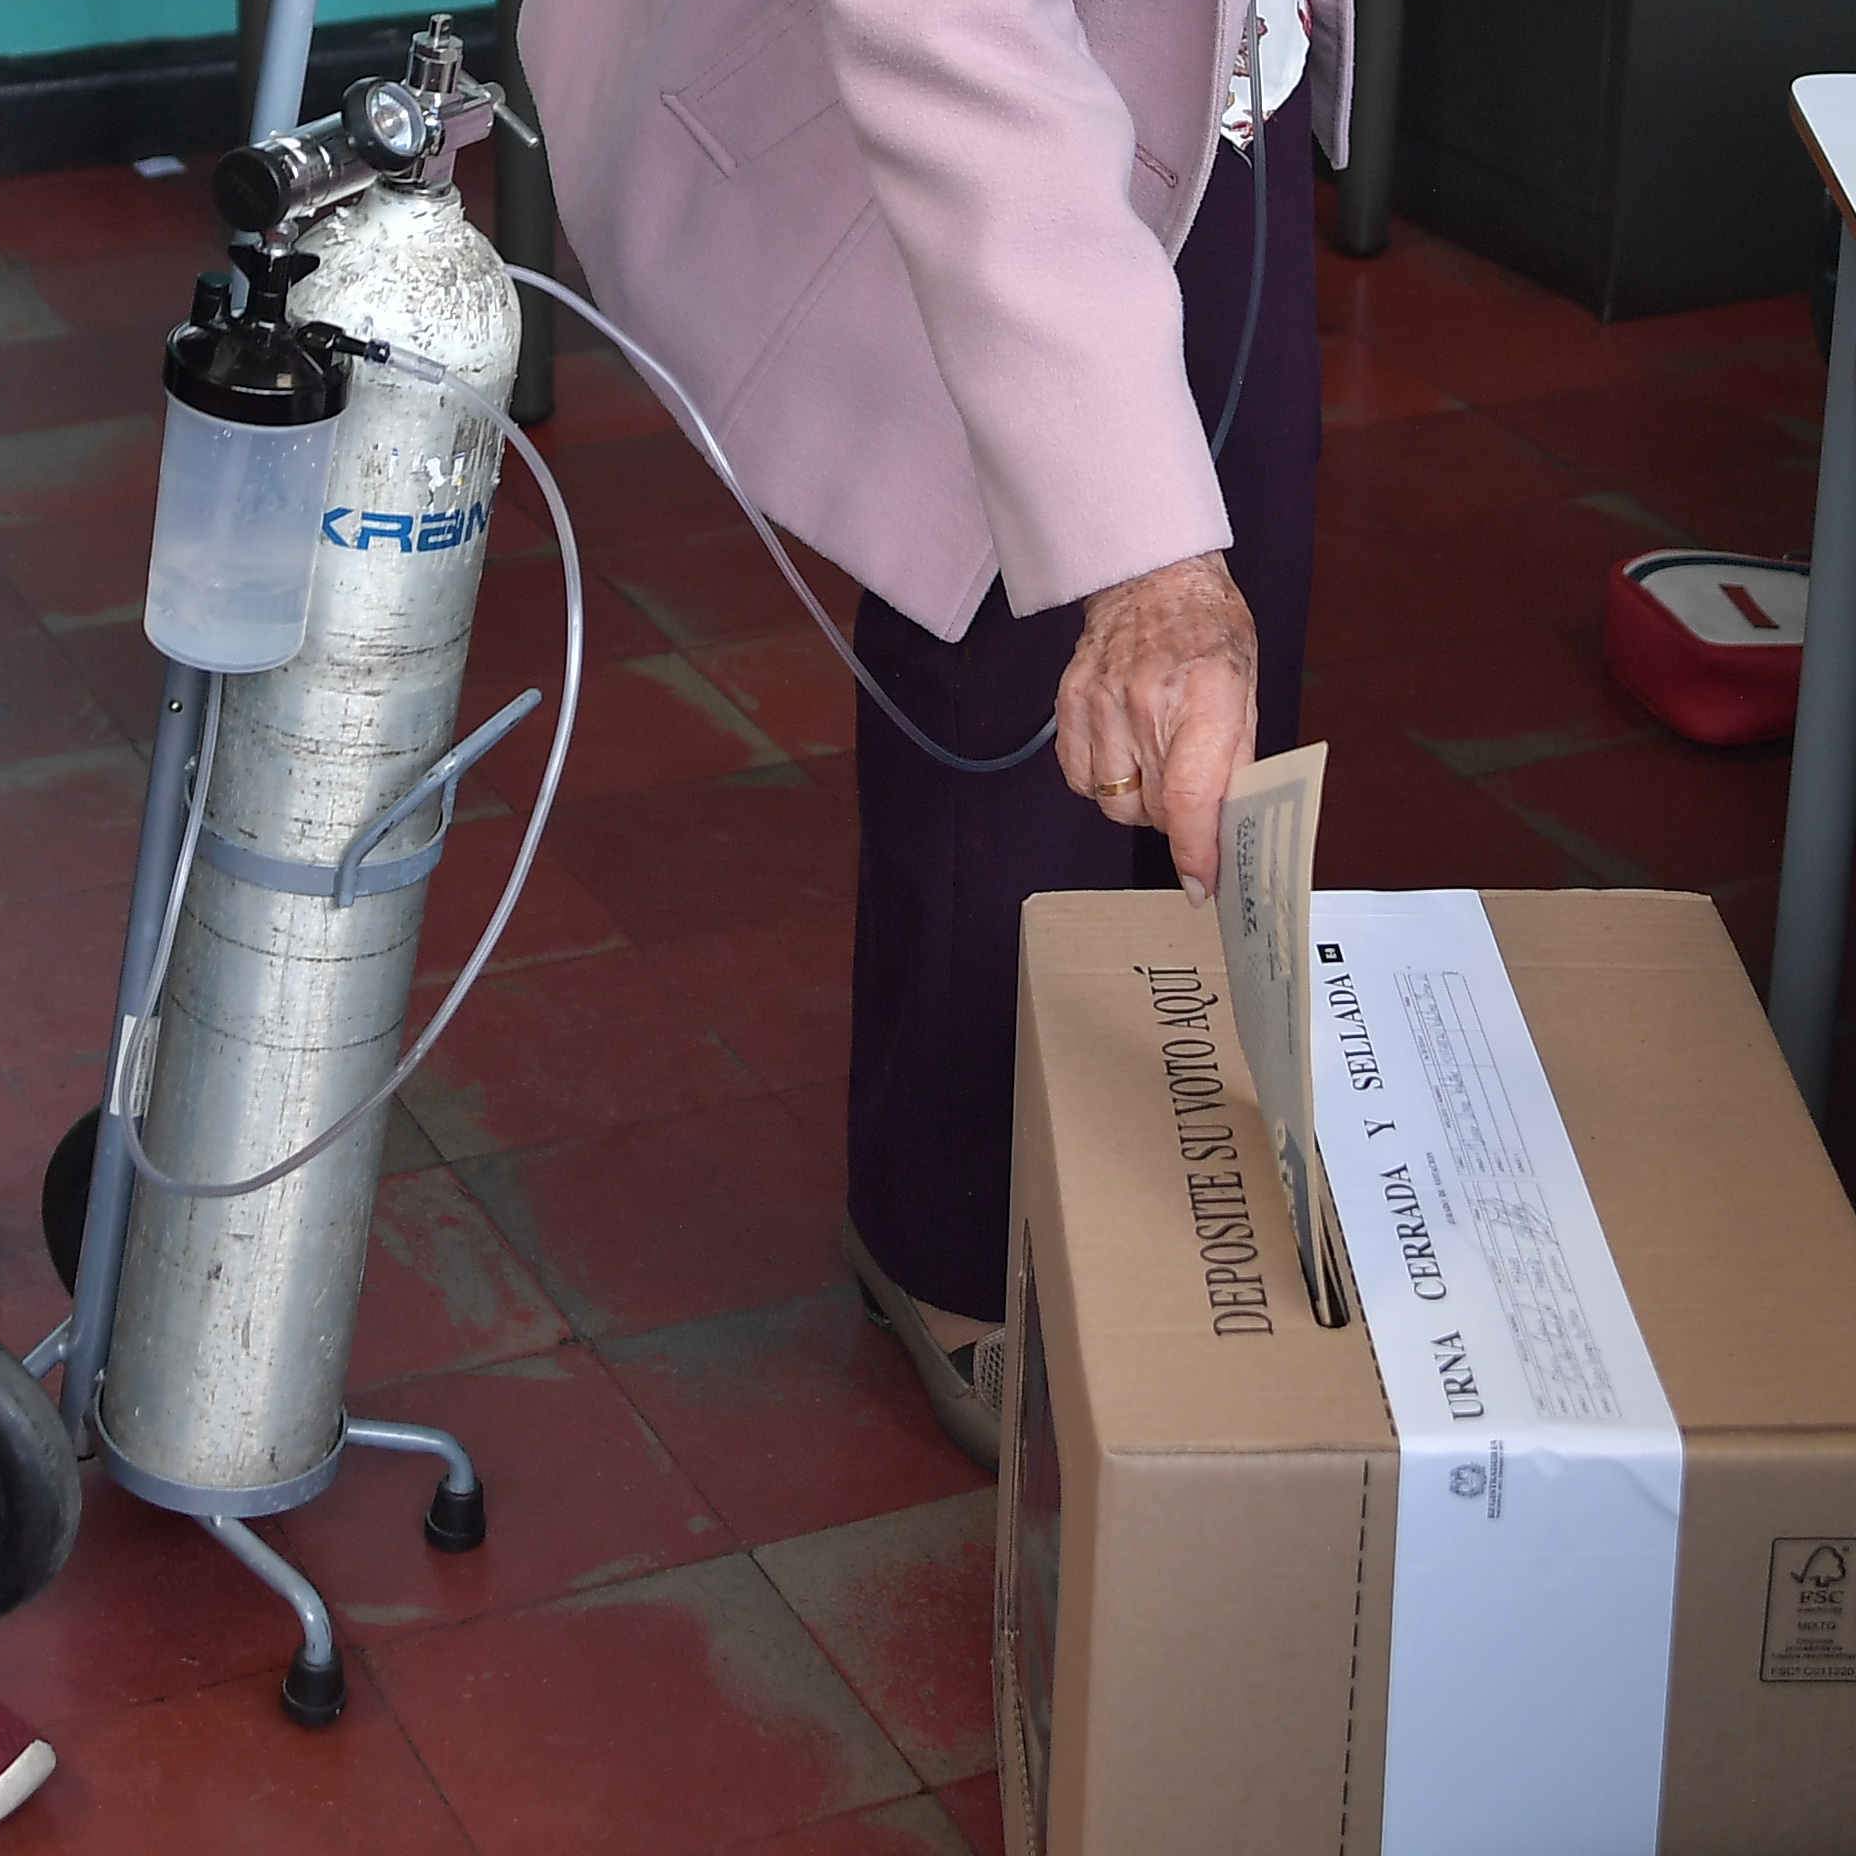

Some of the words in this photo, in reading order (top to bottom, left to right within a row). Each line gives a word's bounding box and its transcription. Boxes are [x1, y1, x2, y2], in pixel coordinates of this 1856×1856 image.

[1133, 965, 1220, 1032] AQUÍ
[1323, 973, 1384, 1092] SELLADA
[1161, 1039, 1226, 1117] VOTO
[1178, 1123, 1239, 1162] SU
[1363, 1118, 1396, 1139] Y
[1186, 1170, 1275, 1337] DEPOSITE
[1380, 1163, 1449, 1302] CERRADA
[1431, 1329, 1486, 1421] URNA
[1799, 1590, 1844, 1604] FSC
